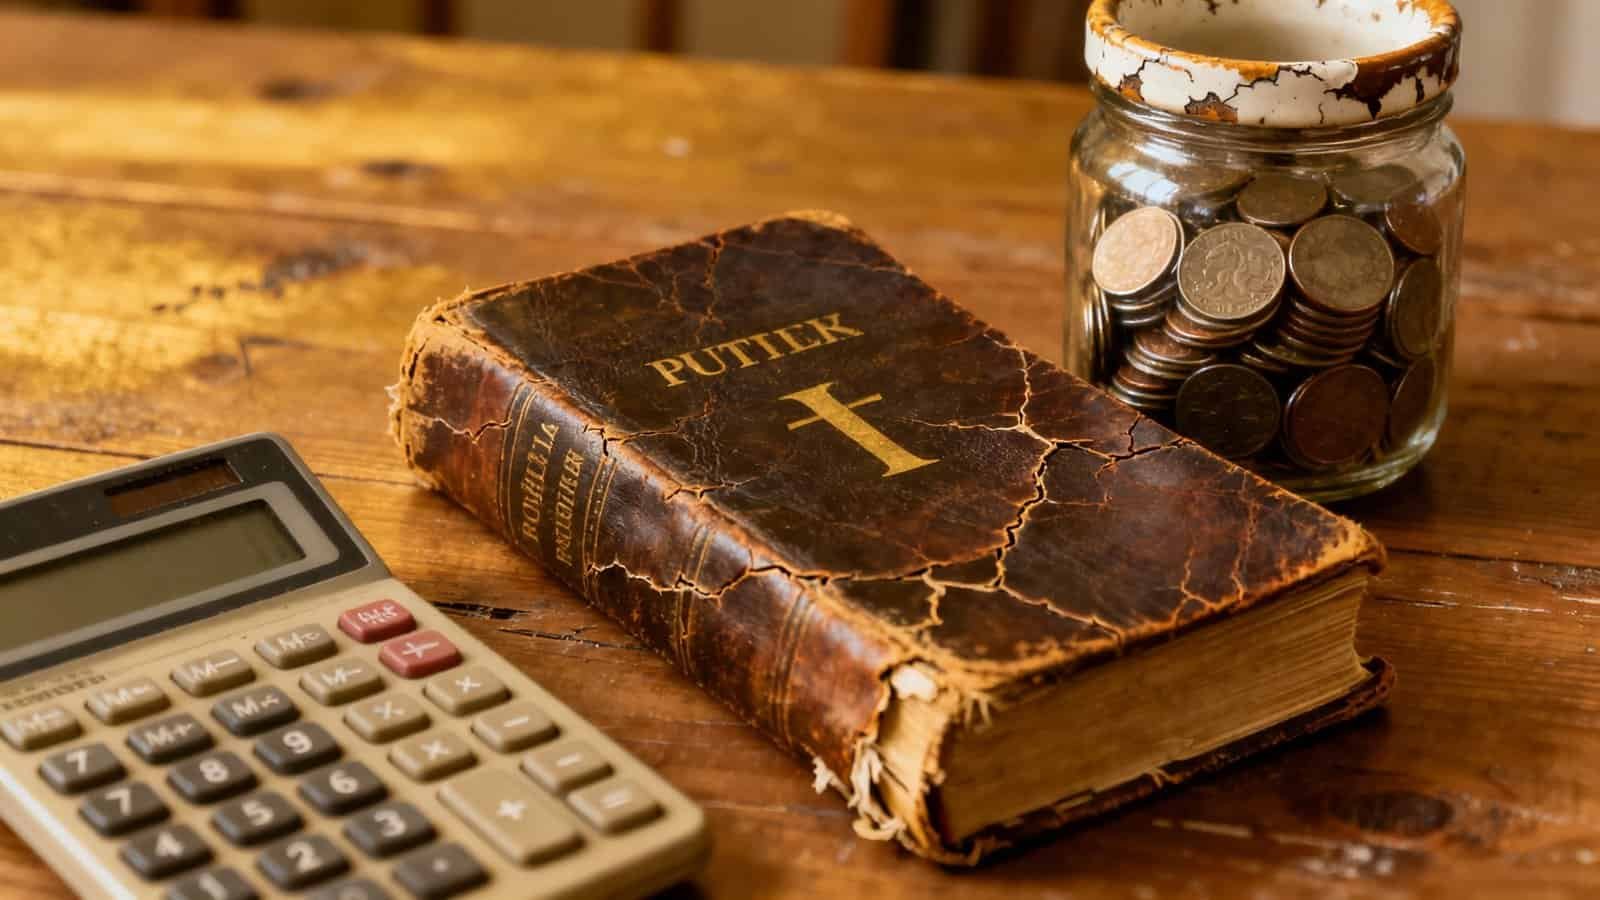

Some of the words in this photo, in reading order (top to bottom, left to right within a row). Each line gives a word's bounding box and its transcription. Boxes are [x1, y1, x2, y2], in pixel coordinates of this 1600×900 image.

[283, 731, 313, 754] 9
[200, 759, 229, 783] 8
[329, 770, 358, 794] 6
[242, 801, 274, 827] 5
[373, 810, 407, 837] 3
[155, 832, 182, 857] 4
[286, 841, 322, 872] 2
